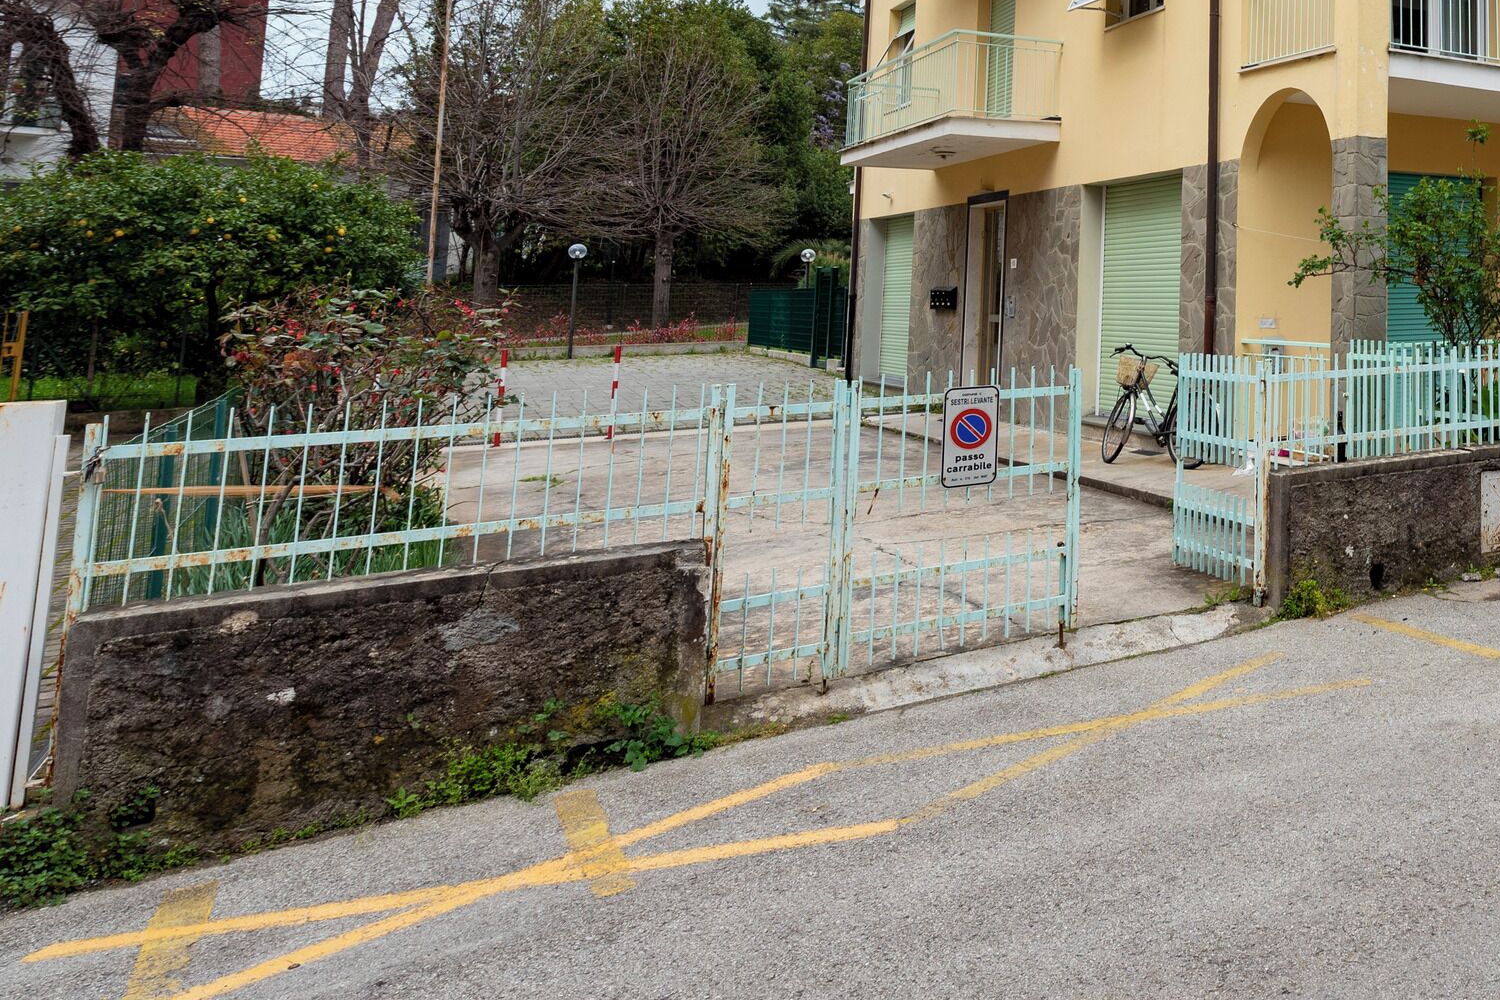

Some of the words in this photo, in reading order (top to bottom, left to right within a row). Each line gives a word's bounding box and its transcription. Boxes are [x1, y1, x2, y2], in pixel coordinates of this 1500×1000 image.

[971, 396, 993, 404] LEVANTE
[955, 453, 984, 463] passo
[946, 462, 992, 473] carrabile
